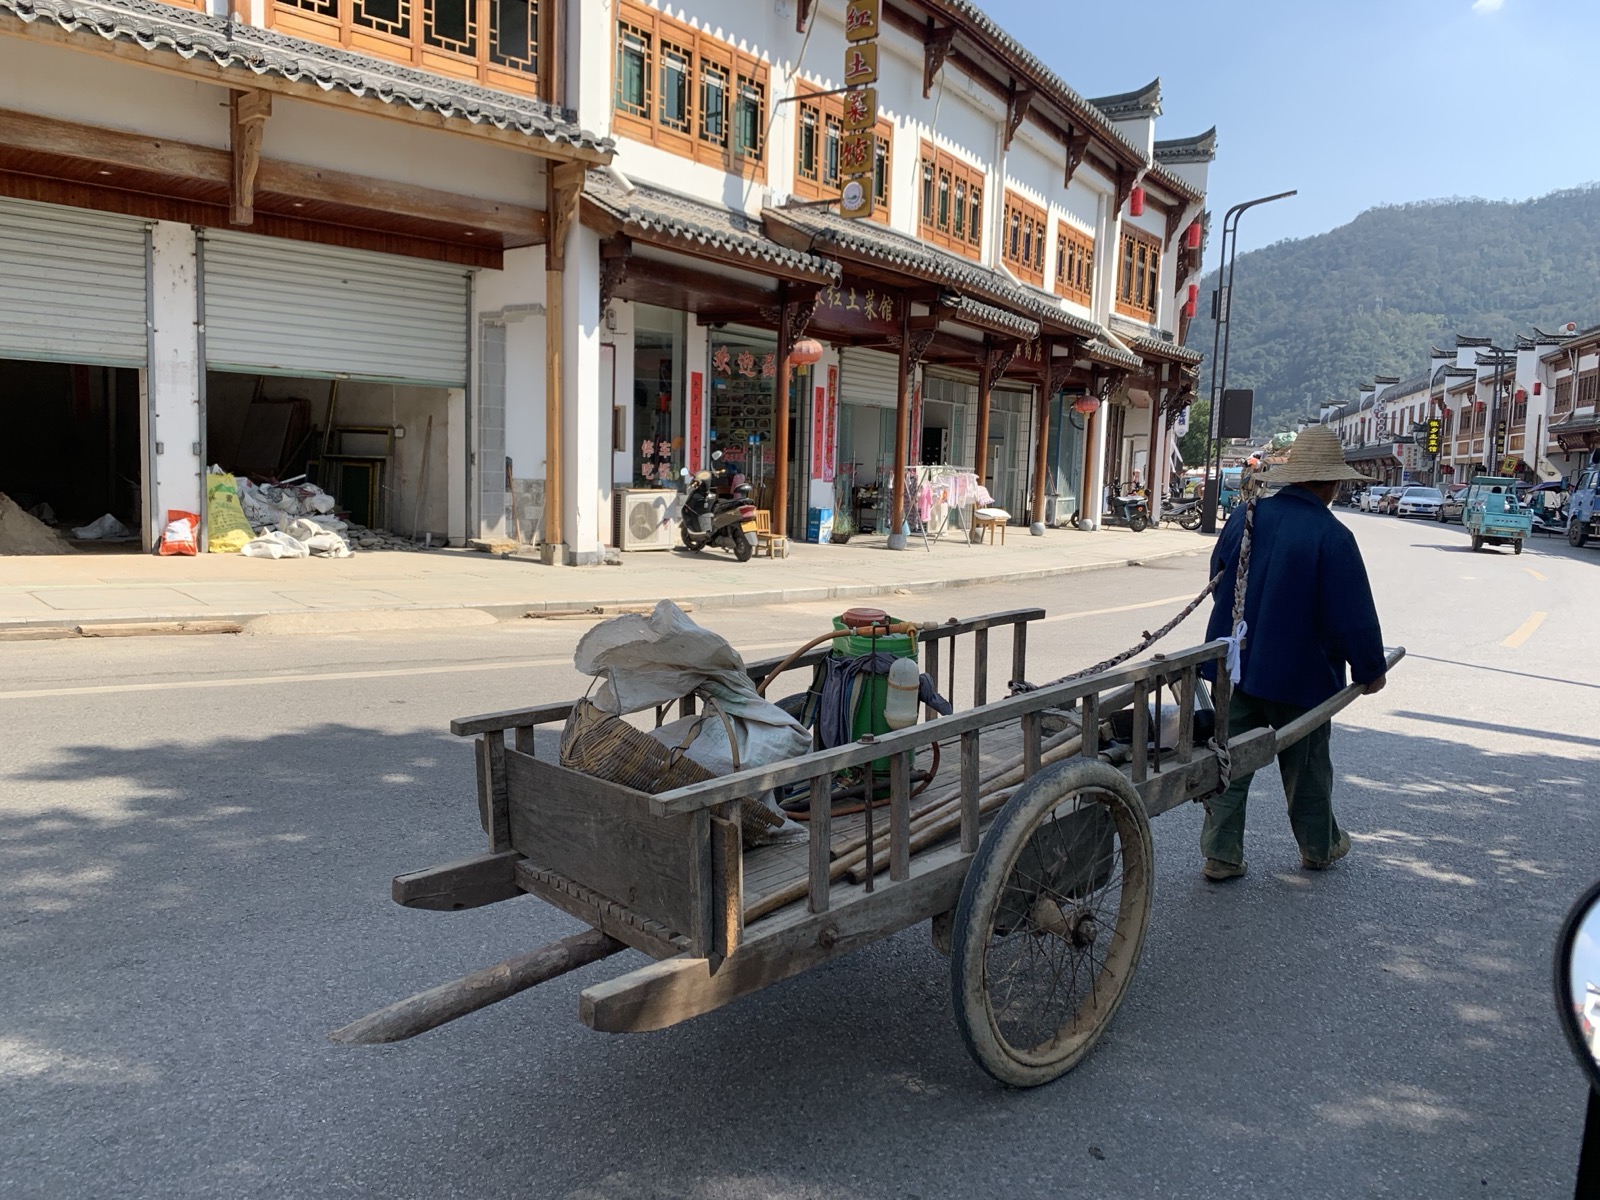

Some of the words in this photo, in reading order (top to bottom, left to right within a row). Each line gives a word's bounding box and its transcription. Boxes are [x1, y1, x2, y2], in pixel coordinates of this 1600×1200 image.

[840, 6, 875, 168] 红土菜馆
[713, 344, 795, 382] 欢迎品
[641, 440, 671, 458] 停车
